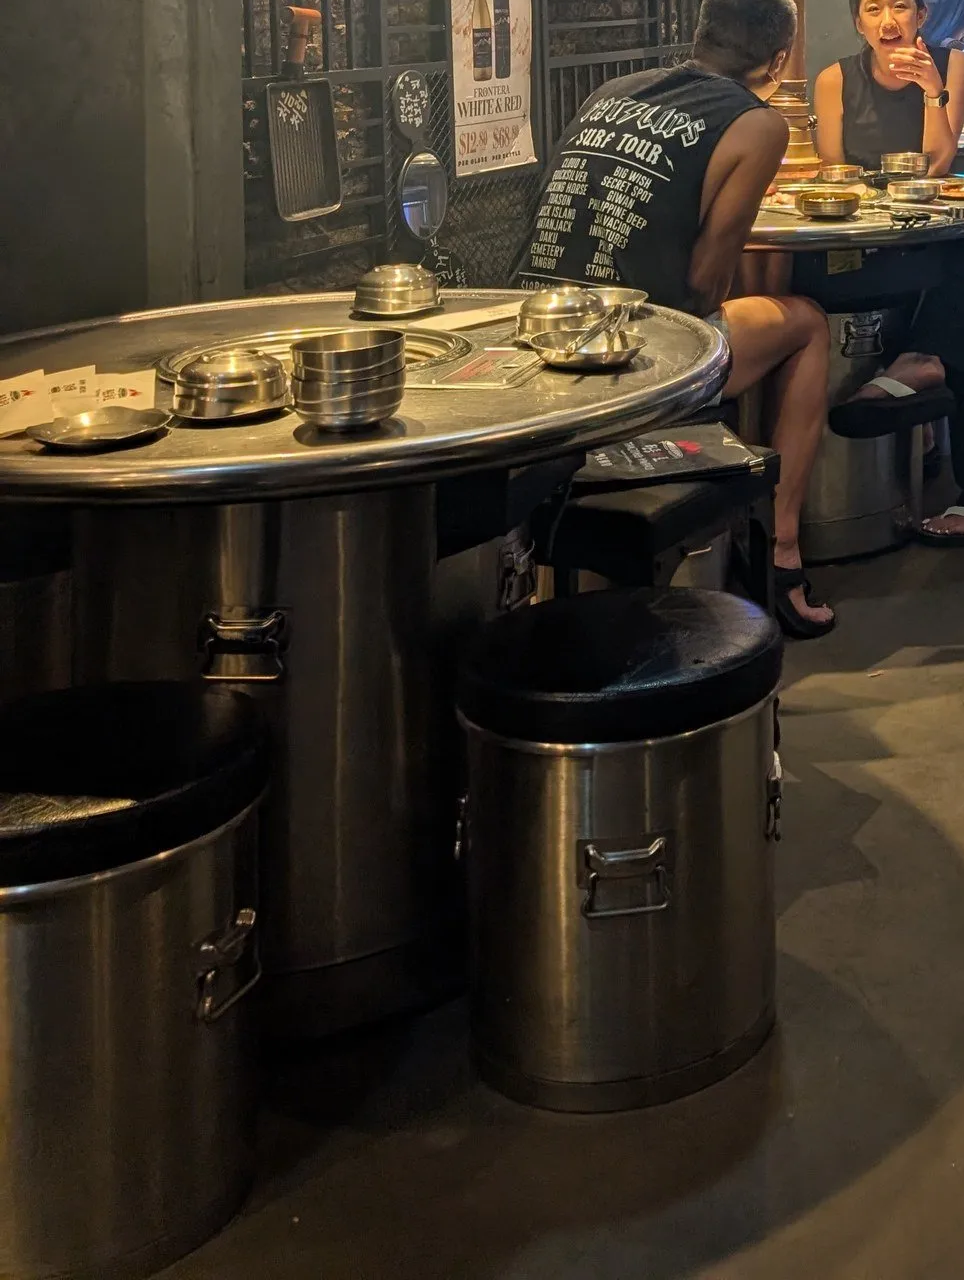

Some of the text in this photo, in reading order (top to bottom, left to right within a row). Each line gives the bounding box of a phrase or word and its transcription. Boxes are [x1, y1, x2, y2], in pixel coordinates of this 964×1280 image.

[473, 85, 510, 98] FRONTERA
[457, 95, 522, 119] WHITE & RED
[576, 128, 663, 165] SURF TOUR
[580, 158, 588, 170] 9
[613, 165, 653, 189] BIG WISH
[565, 182, 589, 196] HORSE
[600, 175, 654, 204] SECRET SPOT
[606, 190, 636, 210] GIWAN
[551, 205, 577, 220] ISLAND
[626, 212, 648, 230] DEEP
[539, 230, 559, 244] DAKU
[530, 242, 565, 258] CEMETERY
